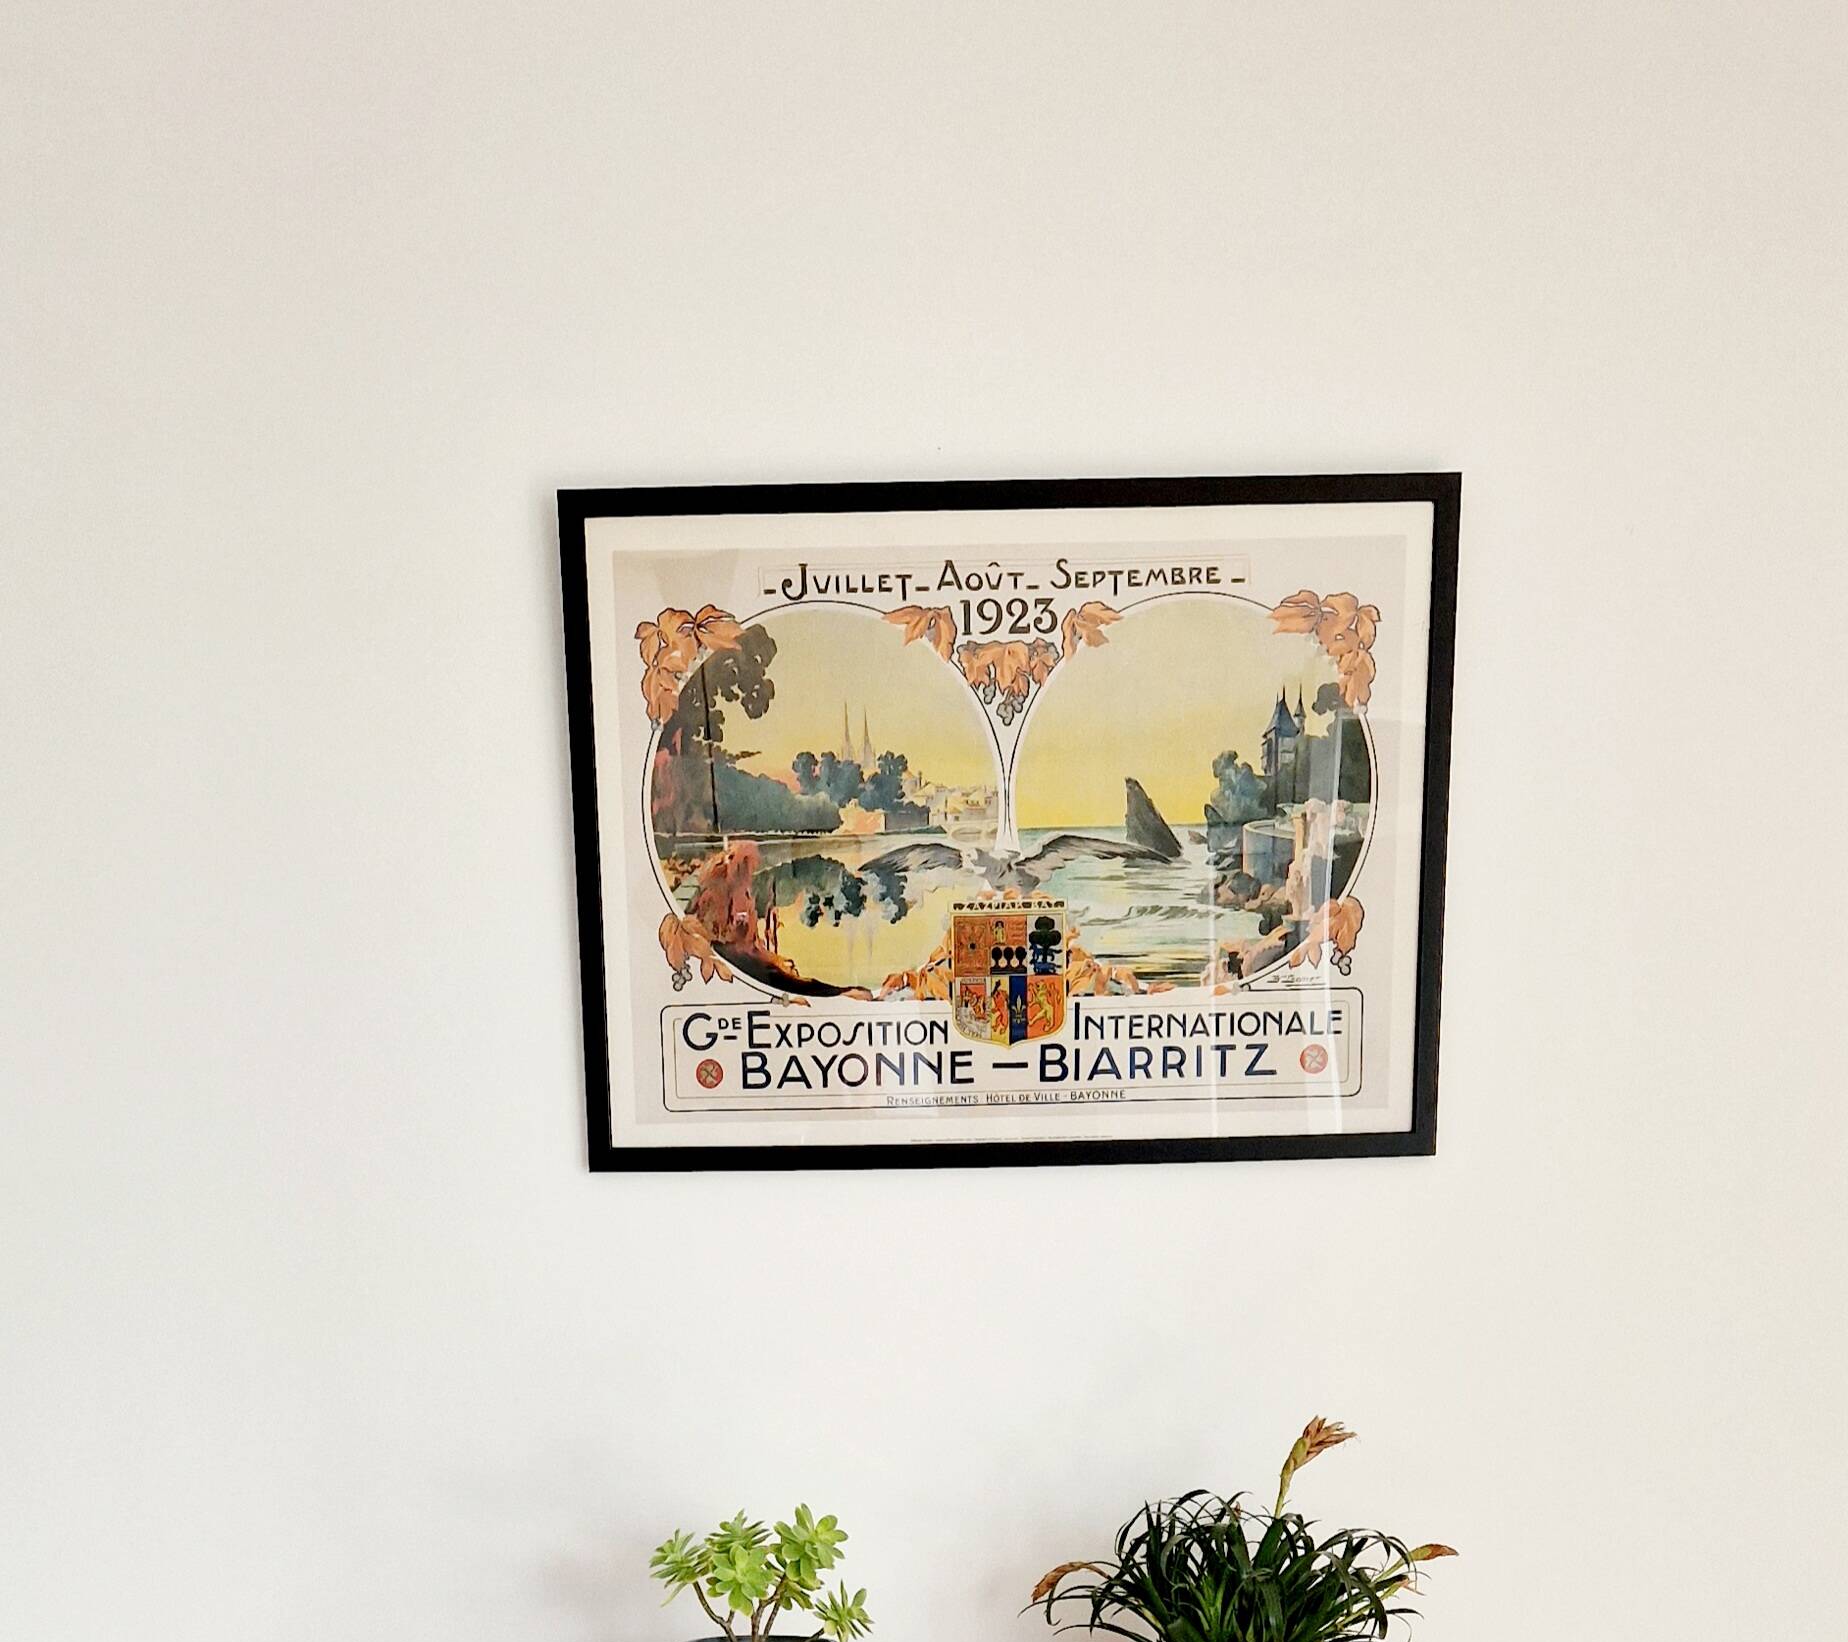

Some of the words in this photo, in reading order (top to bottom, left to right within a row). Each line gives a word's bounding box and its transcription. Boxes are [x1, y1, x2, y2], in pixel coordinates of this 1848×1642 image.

[1050, 558, 1222, 596] SEPTEMBRE
[960, 598, 1058, 636] 1923
[748, 1010, 948, 1049] EXPOSITION
[1074, 1002, 1343, 1040] INTERNATIONALE
[741, 1050, 974, 1089] BAYONNE
[1040, 1043, 1277, 1083] BIARRITZ
[886, 1094, 979, 1106] RENSEIGNEMENTS
[1018, 1094, 1031, 1103] DE
[1034, 1092, 1060, 1102] VILLE
[1070, 1090, 1126, 1101] BAYONNE
